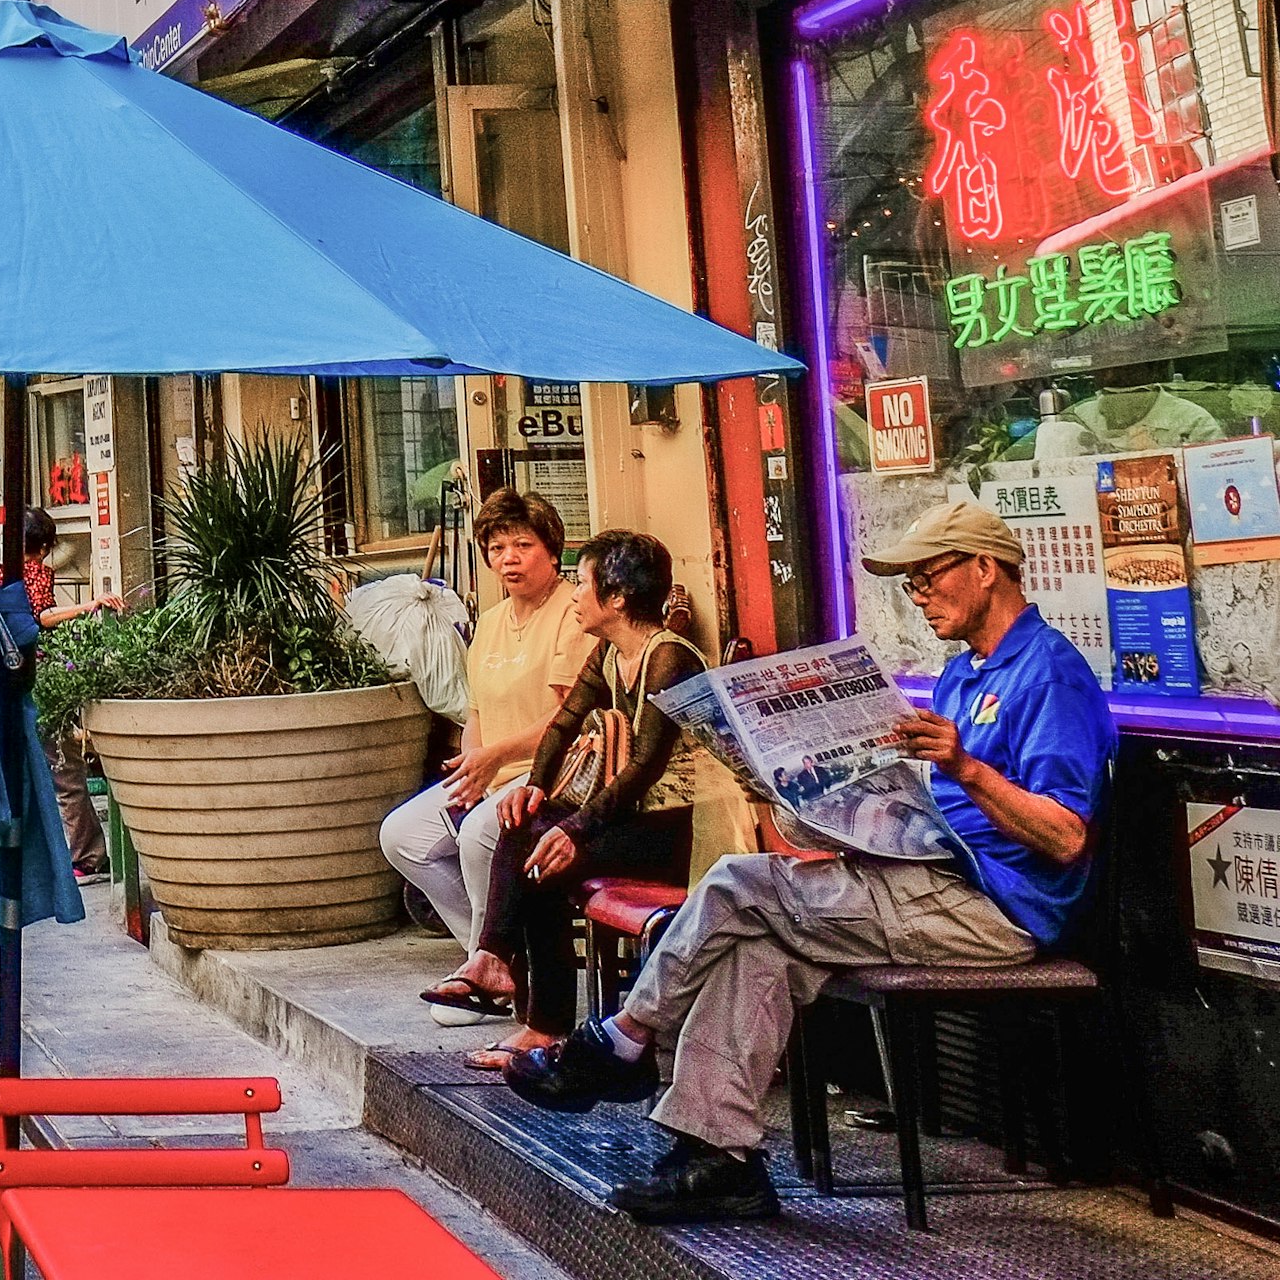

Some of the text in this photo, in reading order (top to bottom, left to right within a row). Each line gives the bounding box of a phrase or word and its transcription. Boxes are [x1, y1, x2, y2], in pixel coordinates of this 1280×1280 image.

[882, 391, 914, 427] NO
[875, 427, 927, 462] SMOKING
[1118, 503, 1161, 518] SYMPHONY
[1119, 518, 1163, 534] ORCHESTRA
[760, 657, 831, 682] 世界日報
[1234, 855, 1279, 900] 陳倩
